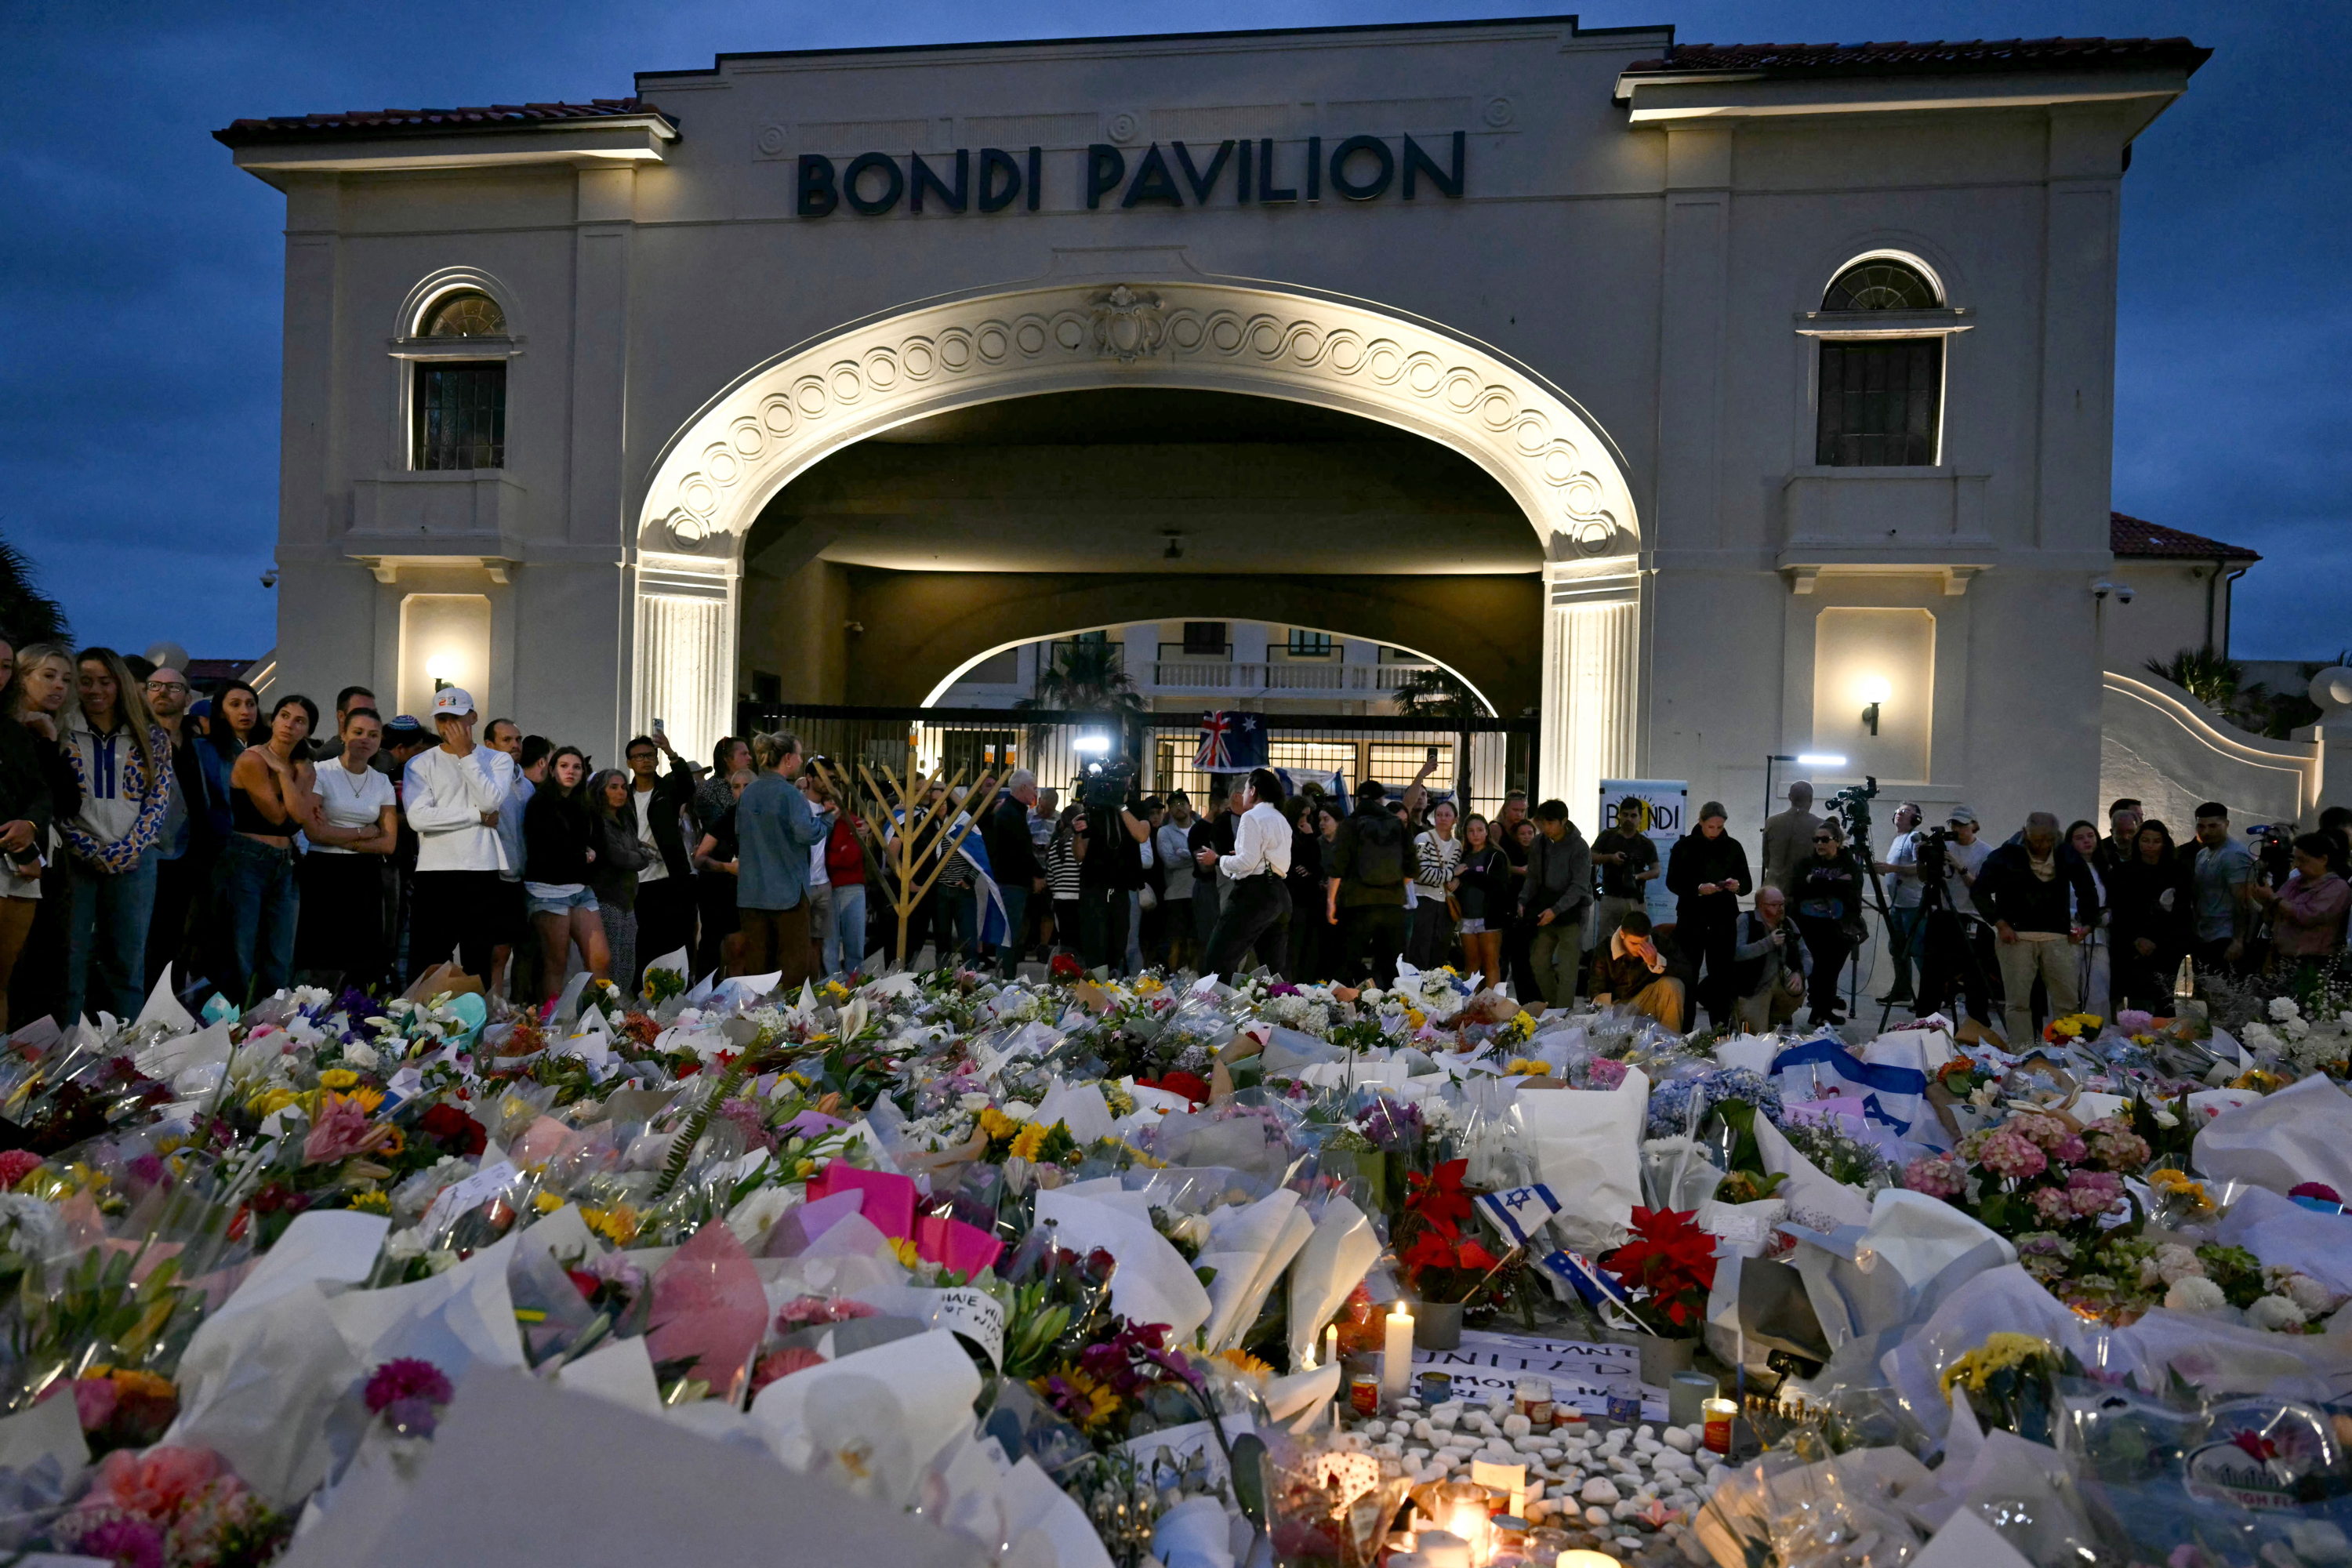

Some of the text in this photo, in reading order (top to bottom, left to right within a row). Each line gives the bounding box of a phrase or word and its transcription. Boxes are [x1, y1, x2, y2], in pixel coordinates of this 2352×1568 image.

[798, 130, 1465, 216] BONDI PAVILION
[1412, 1352, 1632, 1374] UNITED
